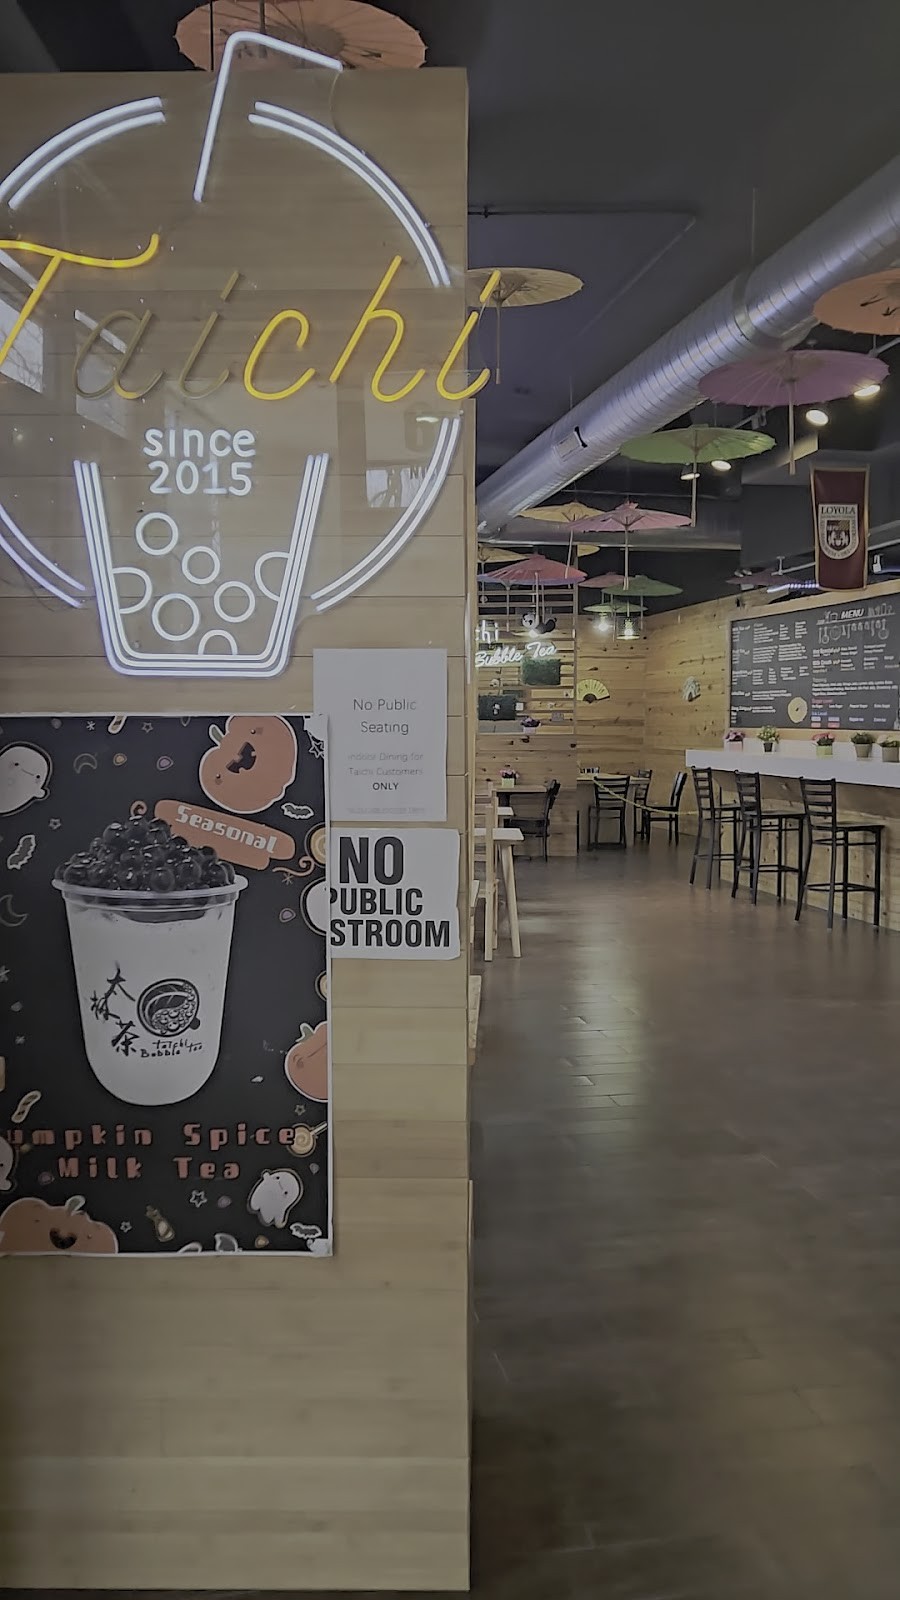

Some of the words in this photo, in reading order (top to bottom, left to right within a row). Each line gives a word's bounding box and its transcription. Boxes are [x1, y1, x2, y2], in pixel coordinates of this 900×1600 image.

[0, 231, 500, 402] Taichi
[142, 427, 256, 457] since
[149, 460, 253, 496] 2015
[821, 506, 856, 515] LOYOLA
[841, 608, 865, 619] MENU
[475, 645, 523, 668] Bubble
[526, 641, 557, 658] Tea
[353, 699, 373, 711] No
[377, 699, 418, 711] Public
[361, 721, 409, 736] Seating
[380, 752, 408, 763] Dining
[411, 752, 424, 761] for
[372, 782, 399, 791] ONLY
[175, 805, 278, 854] Seasonal
[339, 836, 404, 885] NO
[183, 1122, 297, 1150] Spice
[58, 1156, 142, 1179] Milk
[172, 1156, 241, 1179] Tea
